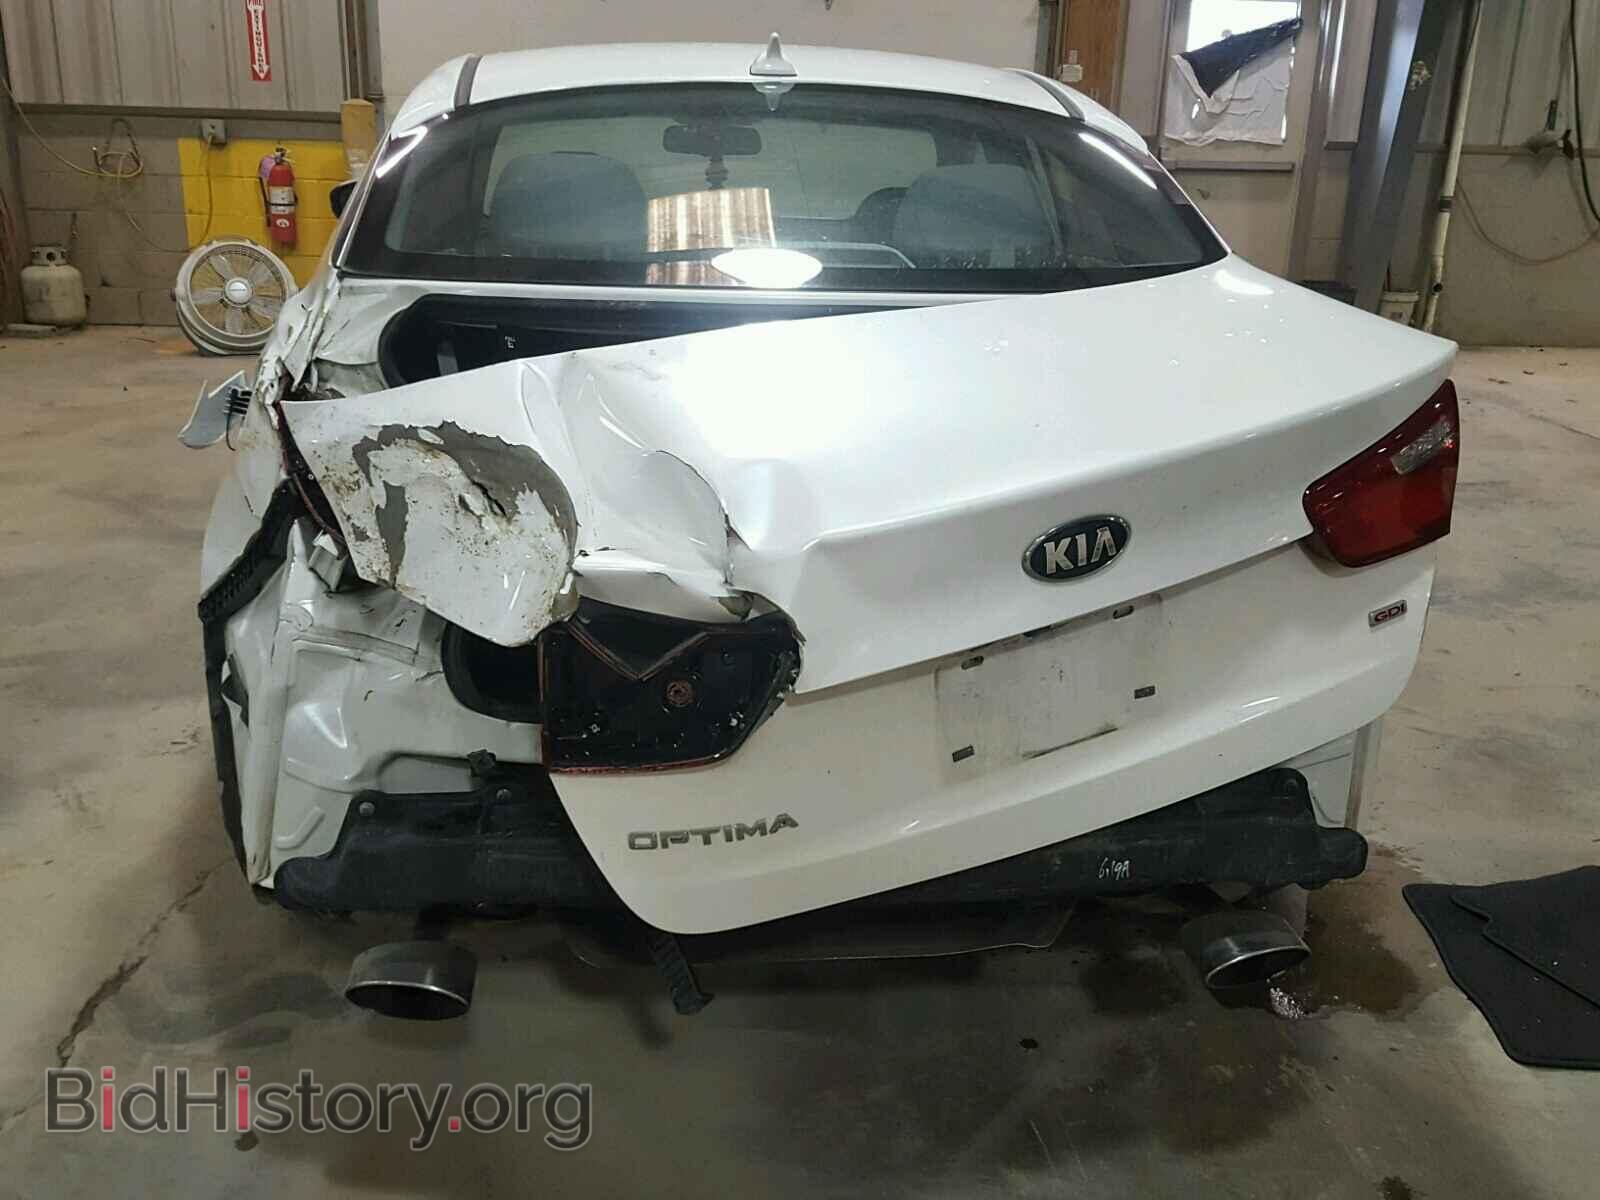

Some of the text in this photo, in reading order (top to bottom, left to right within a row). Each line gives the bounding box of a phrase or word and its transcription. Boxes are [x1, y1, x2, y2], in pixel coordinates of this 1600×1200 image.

[1043, 526, 1117, 575] KIA
[1374, 602, 1405, 622] GDI
[627, 813, 799, 850] OPTIMA
